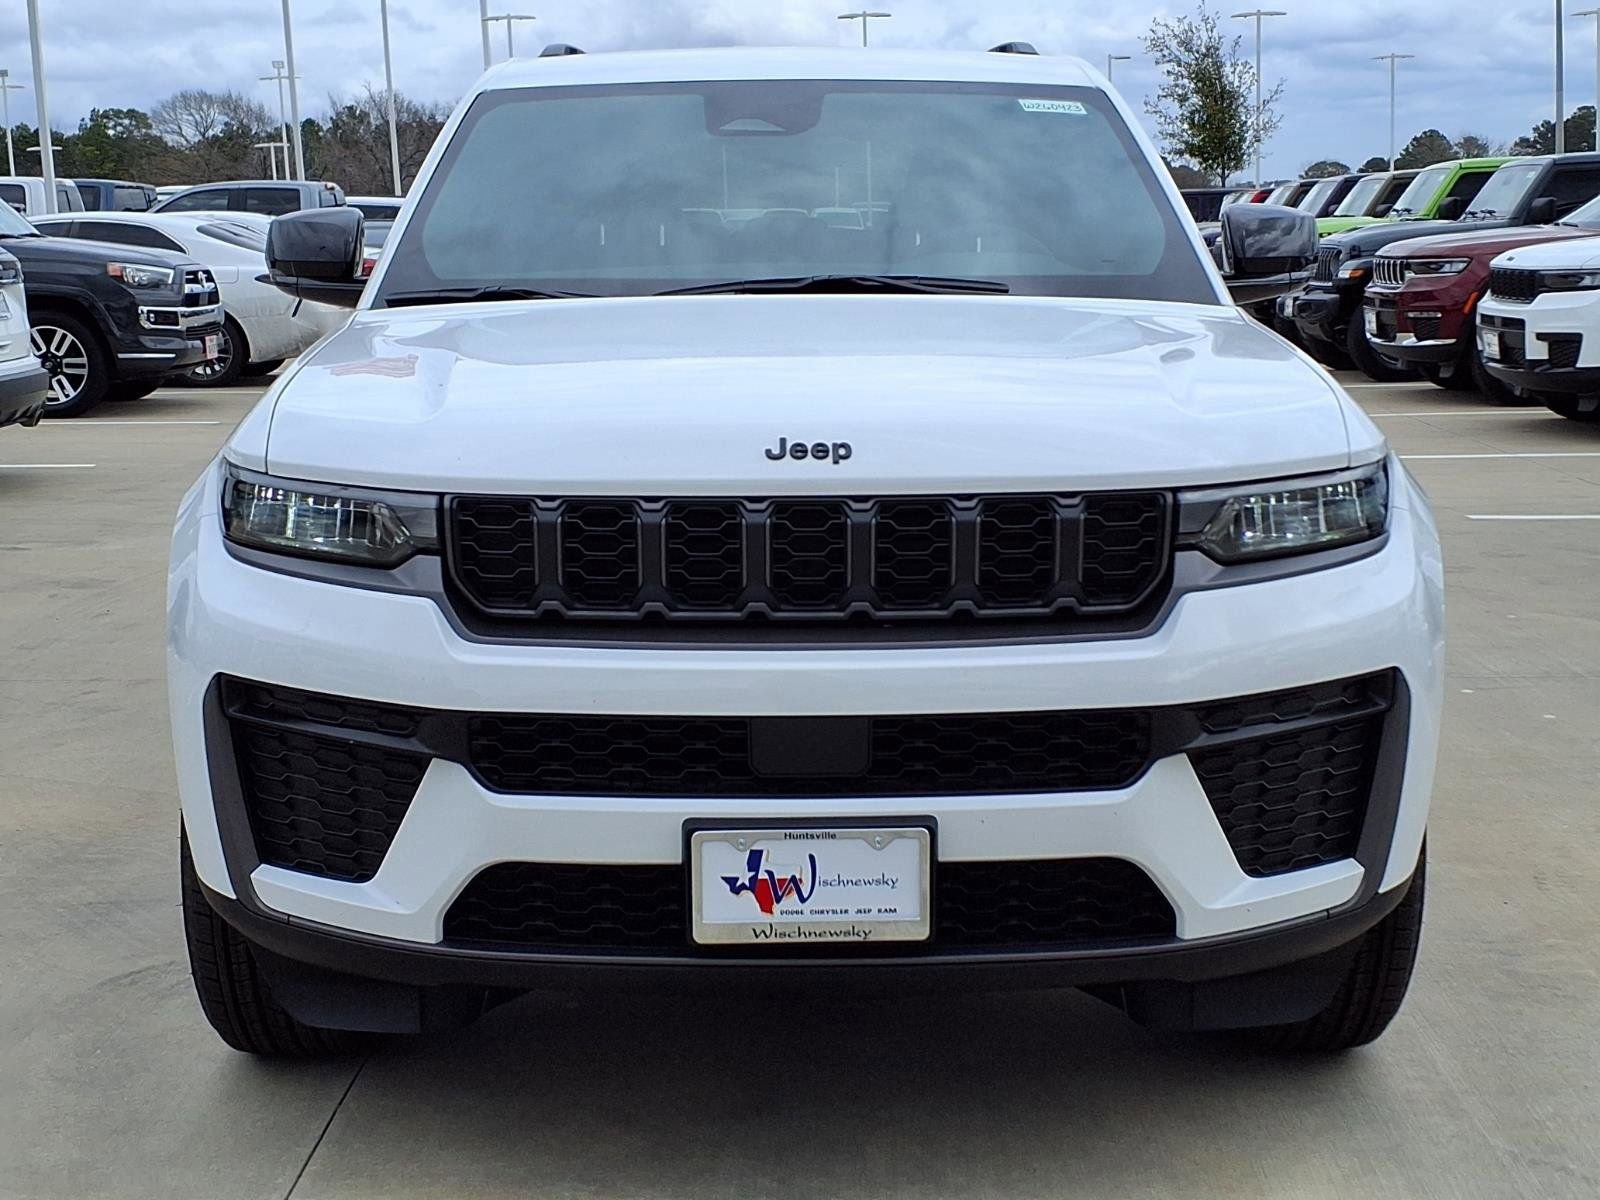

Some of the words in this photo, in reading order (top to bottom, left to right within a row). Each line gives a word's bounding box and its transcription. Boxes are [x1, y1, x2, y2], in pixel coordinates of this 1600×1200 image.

[765, 437, 852, 465] Jeep
[784, 831, 837, 840] Huntsville
[764, 853, 899, 904] Wischnewsky
[752, 923, 872, 940] Wischnewsky
